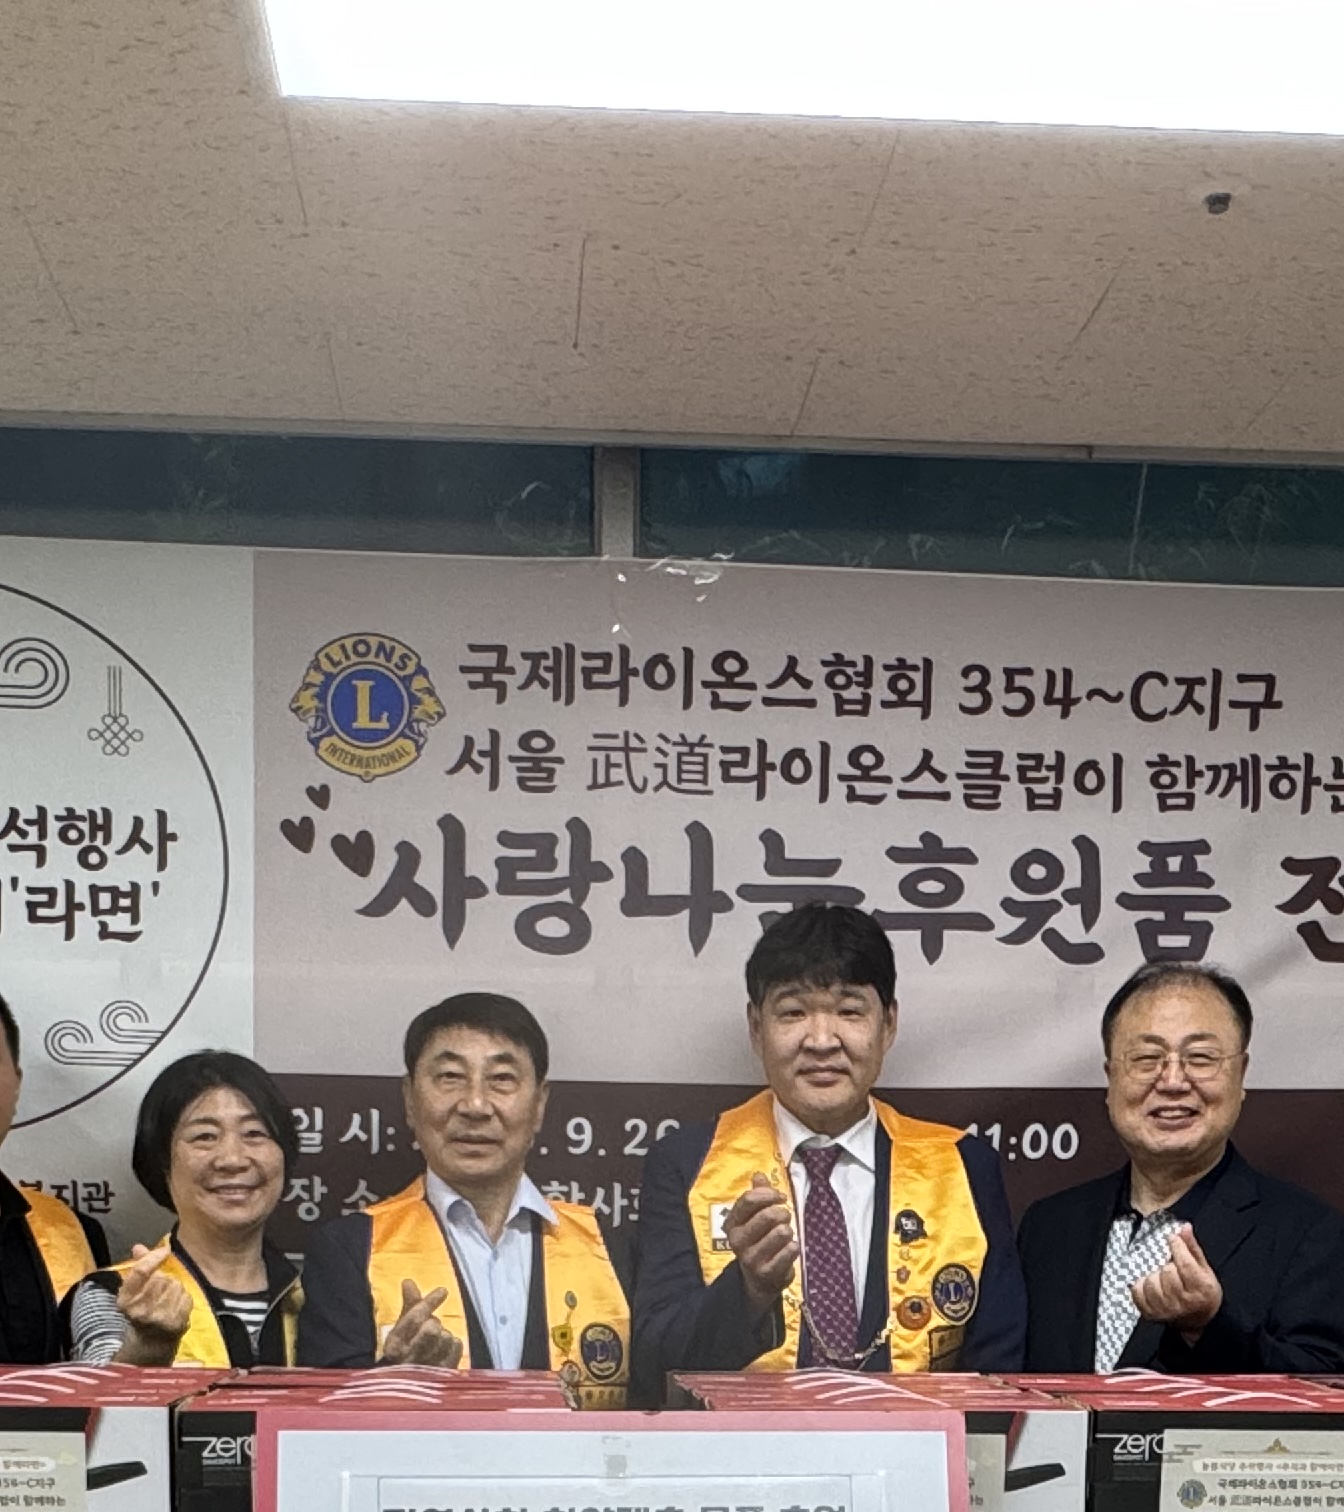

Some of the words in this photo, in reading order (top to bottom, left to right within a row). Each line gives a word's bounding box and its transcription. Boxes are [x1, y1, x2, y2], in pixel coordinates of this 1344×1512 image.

[324, 638, 412, 672] LIONS
[351, 680, 390, 729] L
[459, 643, 934, 719] 국제라이온스협회
[959, 663, 1283, 731] 354~C지구
[325, 743, 412, 770] INTERNATIONAL
[446, 729, 565, 793] 서울
[587, 730, 1124, 813] 武道라이온스클럽이
[339, 1108, 396, 1155] 시:
